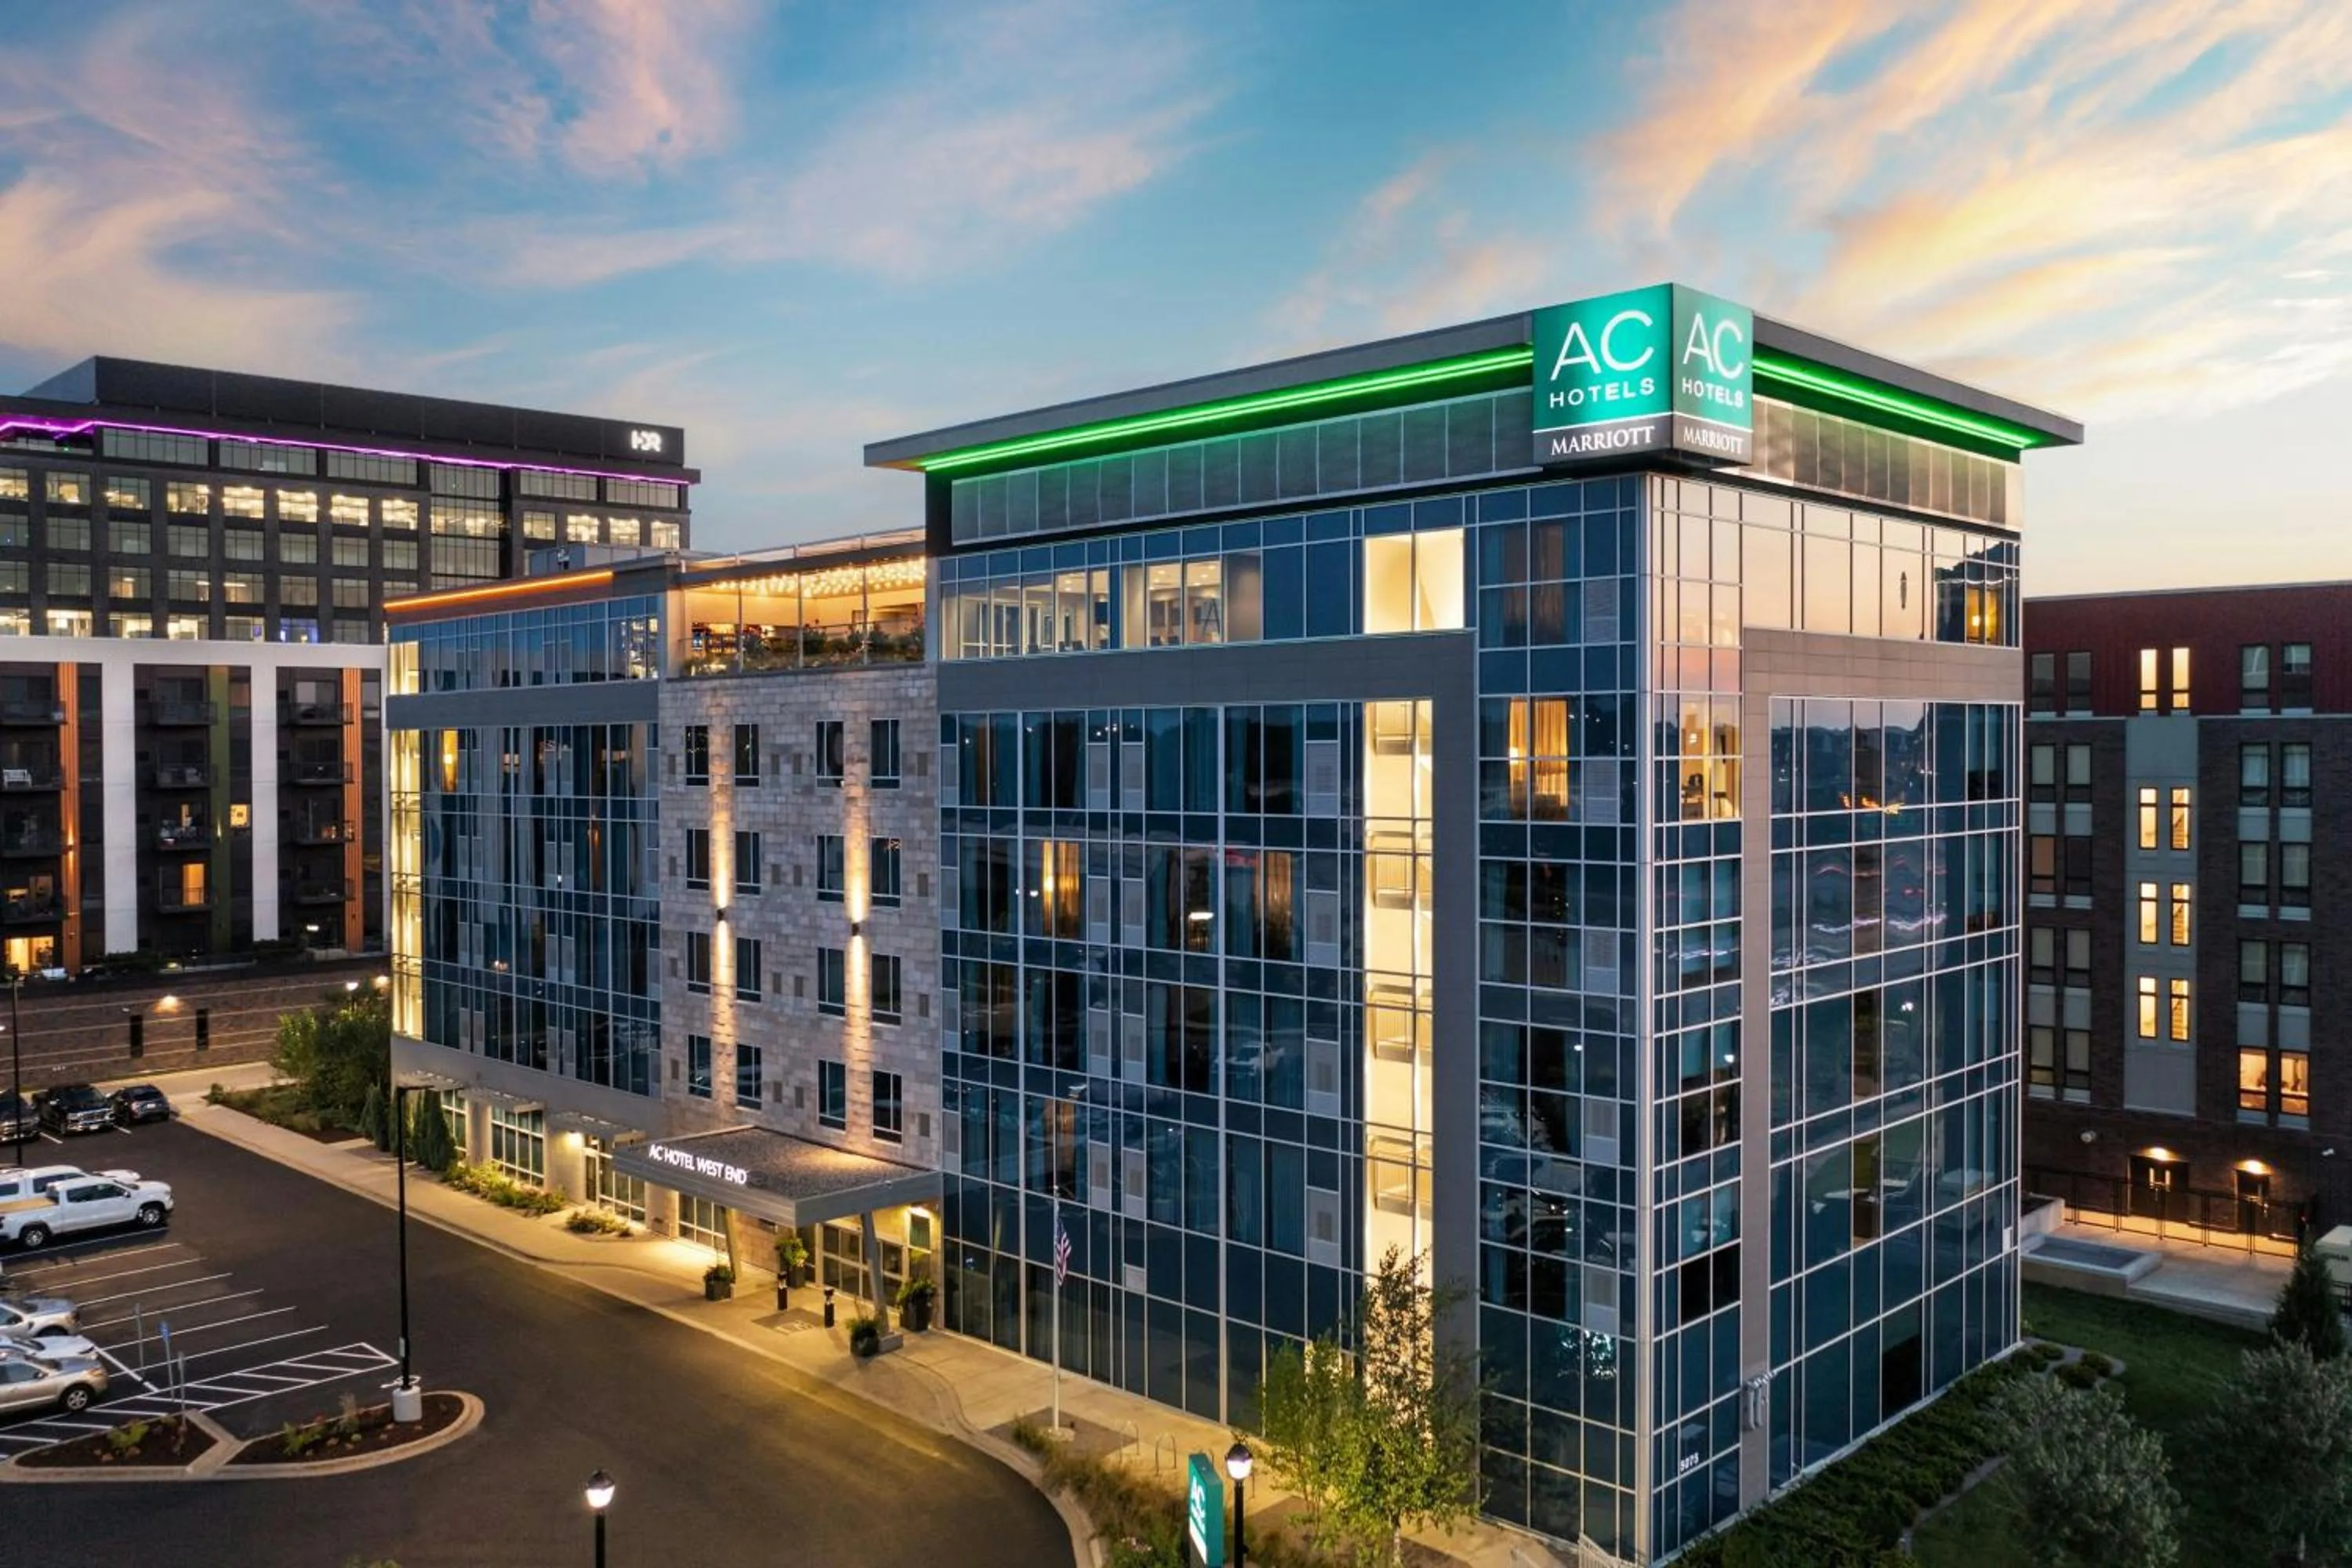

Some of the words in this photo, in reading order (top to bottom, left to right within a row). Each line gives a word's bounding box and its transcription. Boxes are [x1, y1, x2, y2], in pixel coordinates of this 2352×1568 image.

[1550, 310, 1654, 382] AC
[1682, 313, 1744, 379] AC
[1549, 377, 1656, 408] HOTELS
[1682, 377, 1744, 408] HOTELS
[1551, 426, 1655, 456] MARRIOTT
[1683, 426, 1744, 455] MARRIOTT
[648, 1144, 665, 1160] AC
[664, 1147, 695, 1171] HOTEL
[696, 1157, 723, 1179] WEST
[725, 1165, 747, 1185] END
